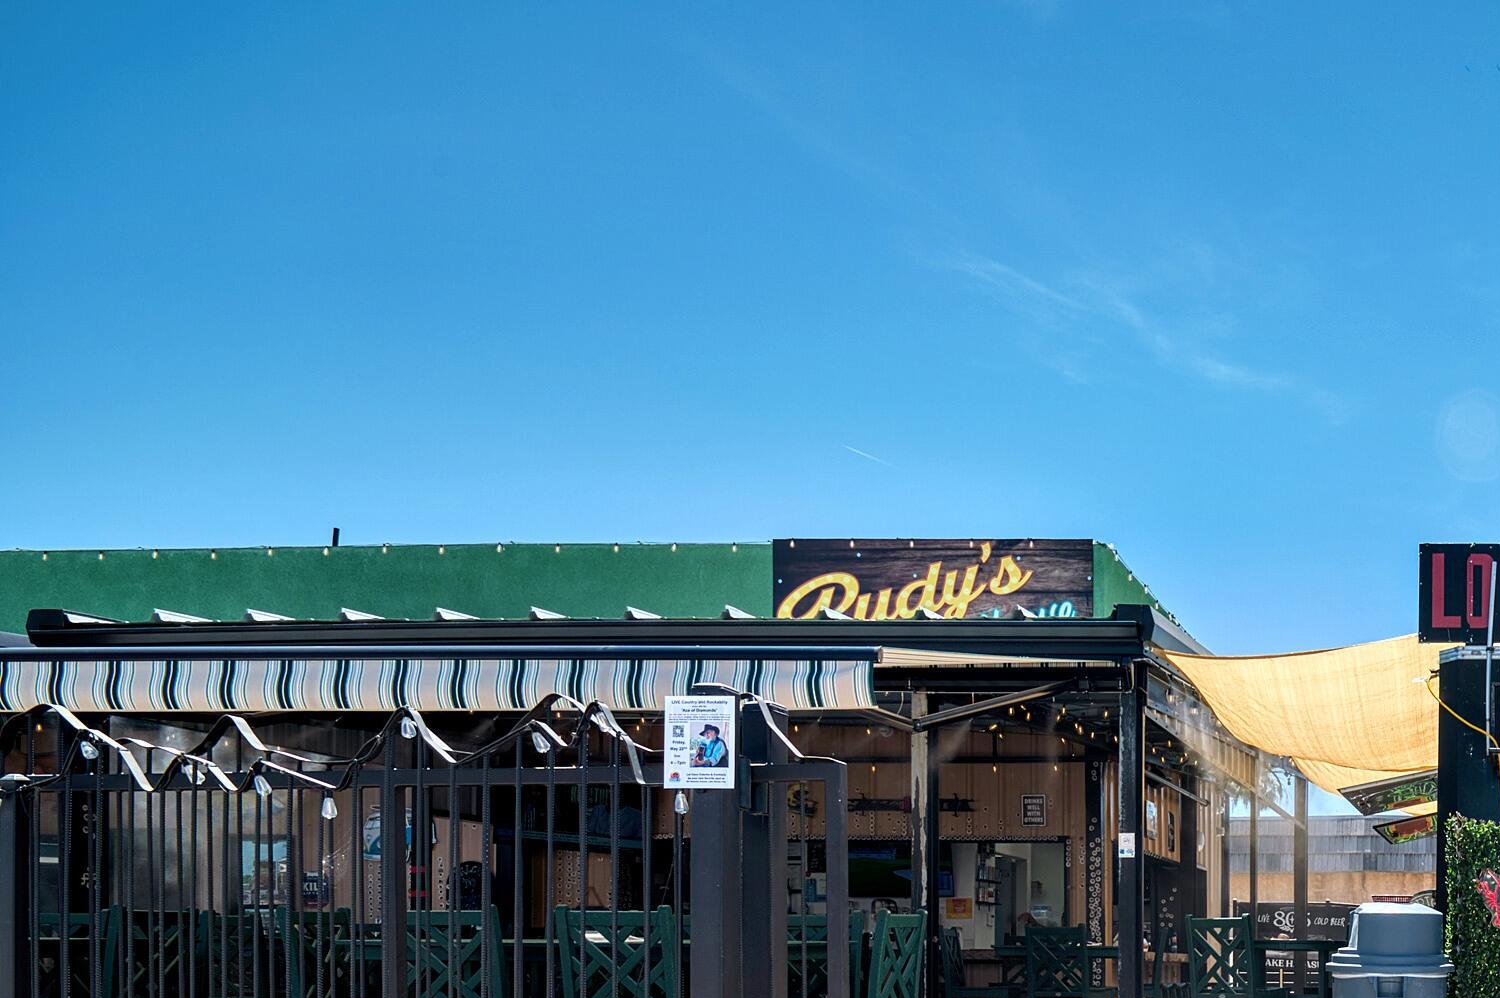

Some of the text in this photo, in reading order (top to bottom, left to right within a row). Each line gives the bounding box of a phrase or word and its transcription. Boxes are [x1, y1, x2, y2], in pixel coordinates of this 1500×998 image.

[777, 542, 1034, 619] Rudy's
[1257, 913, 1271, 923] LIVE
[1313, 917, 1329, 926] COLD
[1329, 916, 1346, 927] BEER
[1265, 959, 1285, 968] AKE
